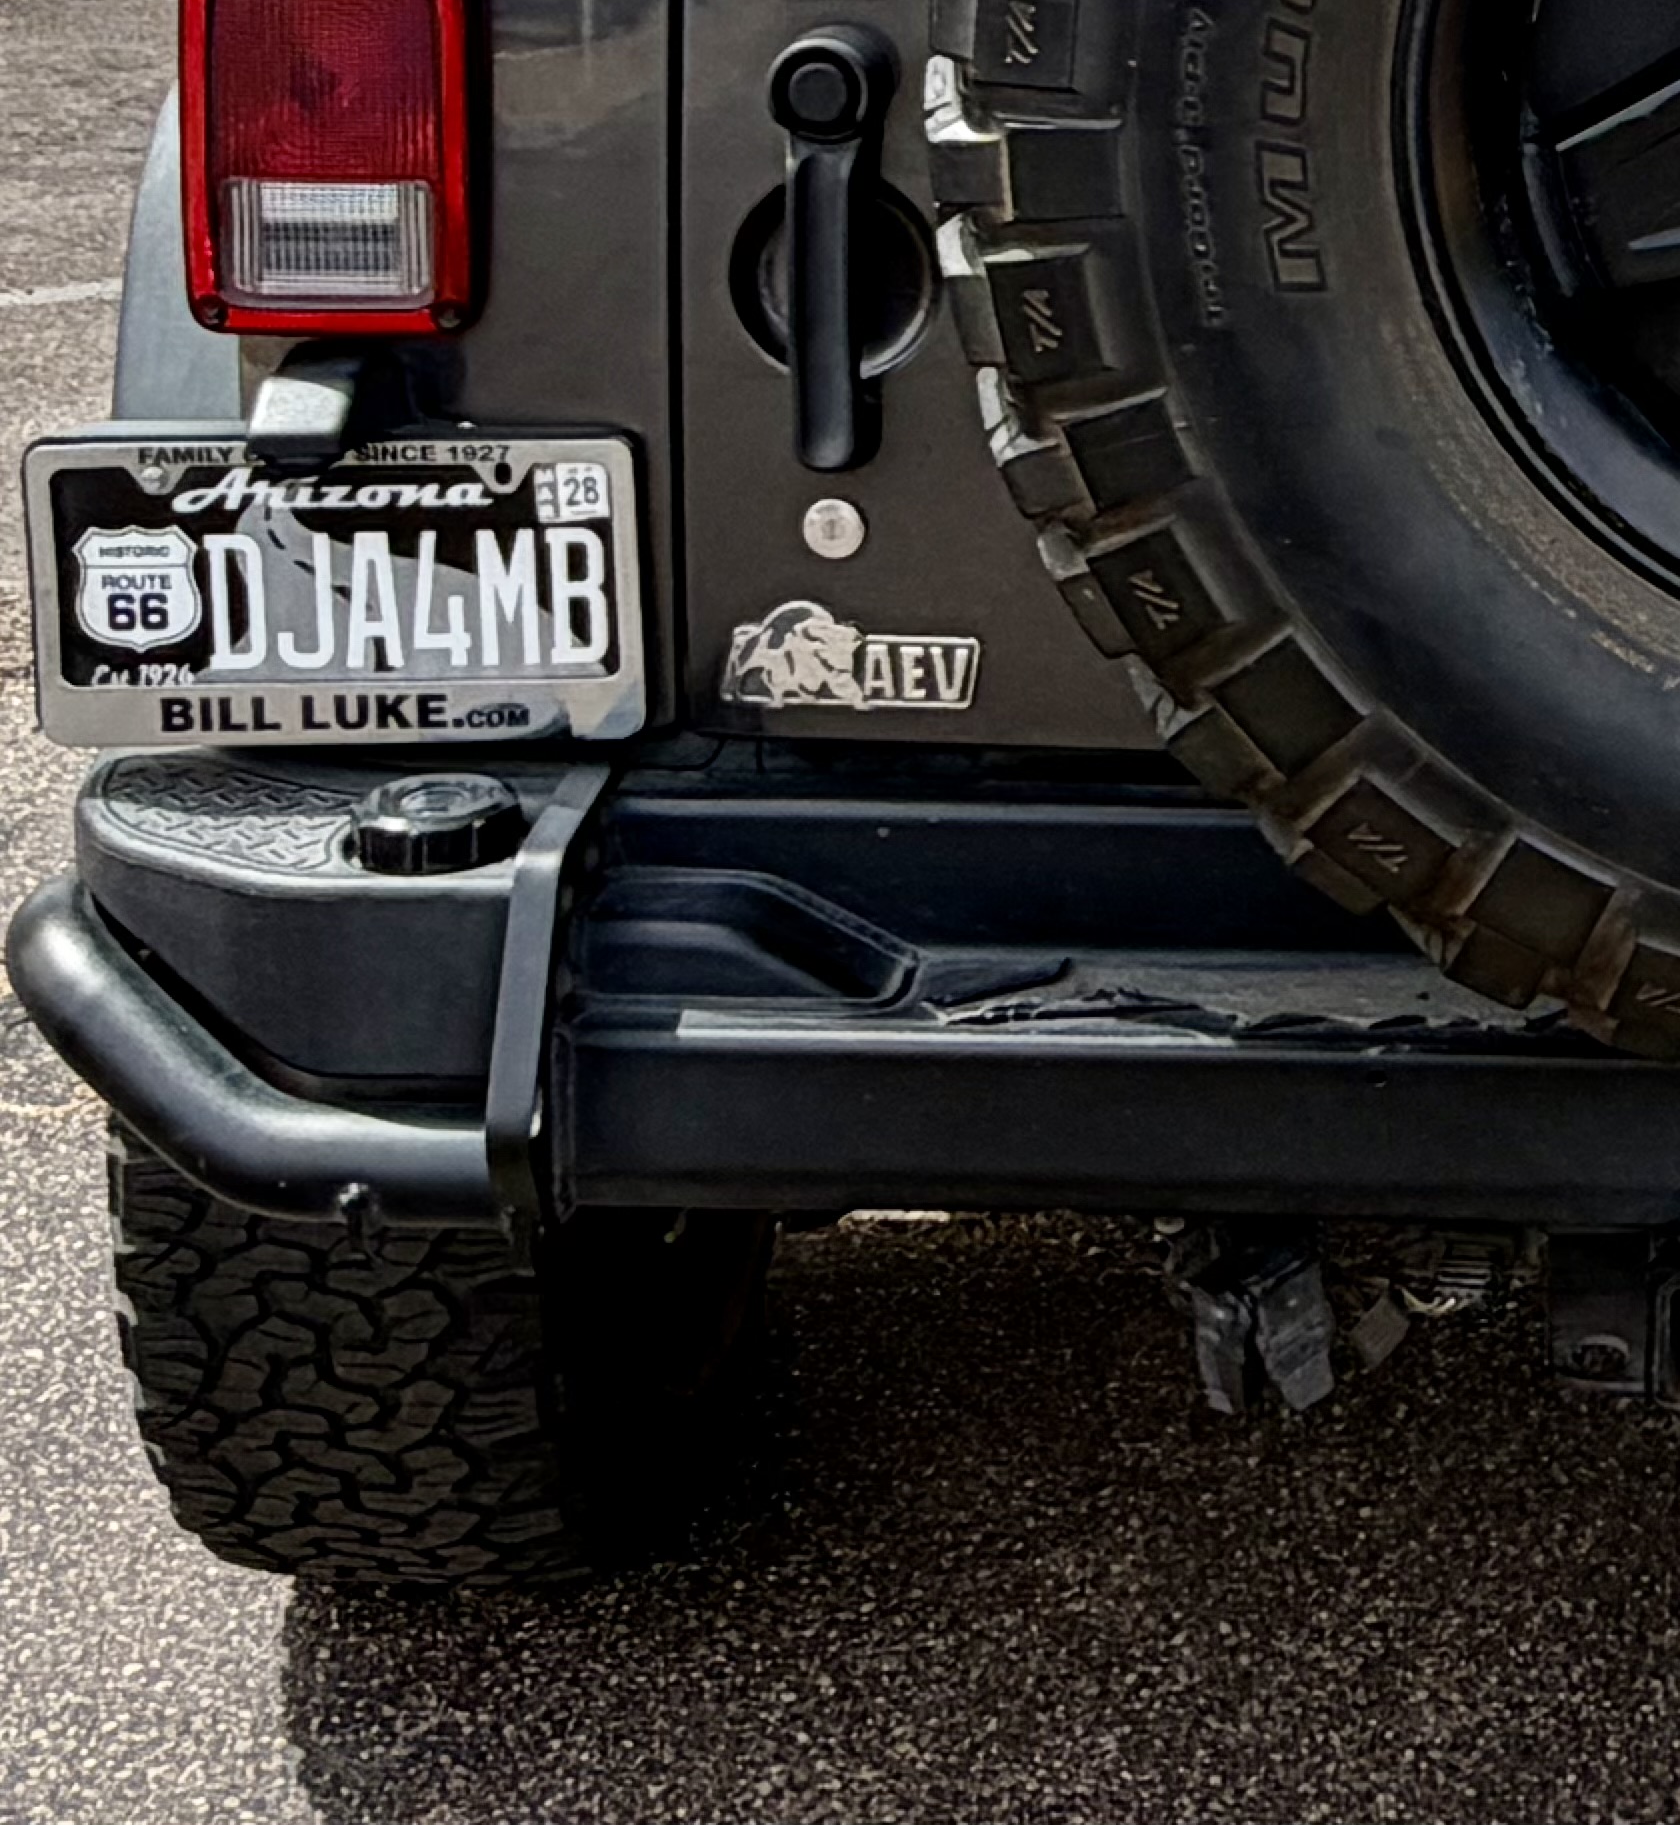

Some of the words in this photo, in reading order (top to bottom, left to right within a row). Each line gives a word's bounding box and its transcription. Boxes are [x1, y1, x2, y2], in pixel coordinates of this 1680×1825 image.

[138, 447, 233, 465] FAMILY
[353, 445, 437, 462] SINCE
[447, 445, 510, 462] 1927
[172, 468, 493, 514] Arizona
[563, 476, 600, 507] 28
[99, 546, 171, 558] HISTORIC
[102, 575, 172, 590] ROUTE
[107, 593, 169, 631] 66
[203, 528, 609, 670] DJA4MB
[139, 663, 195, 686] 1926
[864, 644, 969, 701] AEV
[160, 696, 282, 732] BILL
